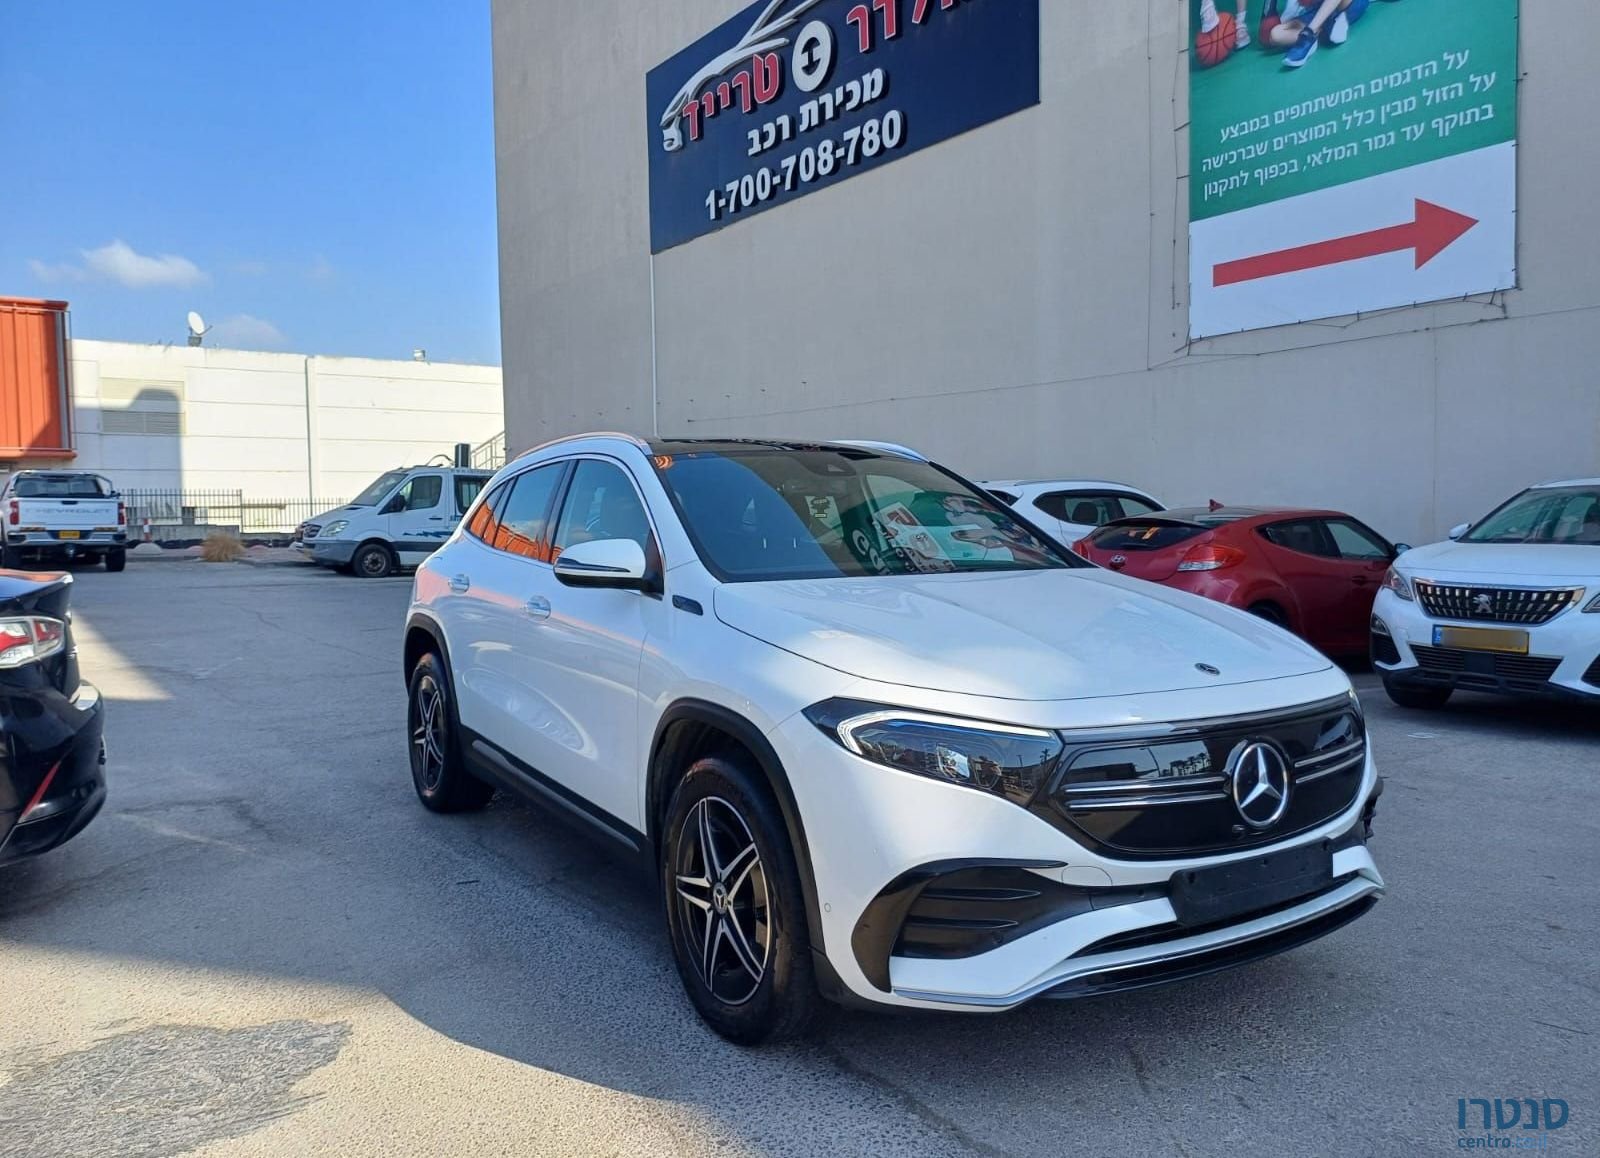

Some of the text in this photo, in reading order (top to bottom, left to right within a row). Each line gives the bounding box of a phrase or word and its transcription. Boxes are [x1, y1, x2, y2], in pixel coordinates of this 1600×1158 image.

[682, 52, 779, 141] טרייד
[747, 68, 884, 156] מכירת רכב
[1202, 71, 1496, 172] על הזול מבין כלל המוצרים שברכישה
[1220, 49, 1470, 143] על הדגמים המשתתפים במבצע
[705, 109, 902, 220] 1-700-708-780
[1203, 103, 1494, 202] בתוקף עד גמר המלאי, בכפוף לתקנון
